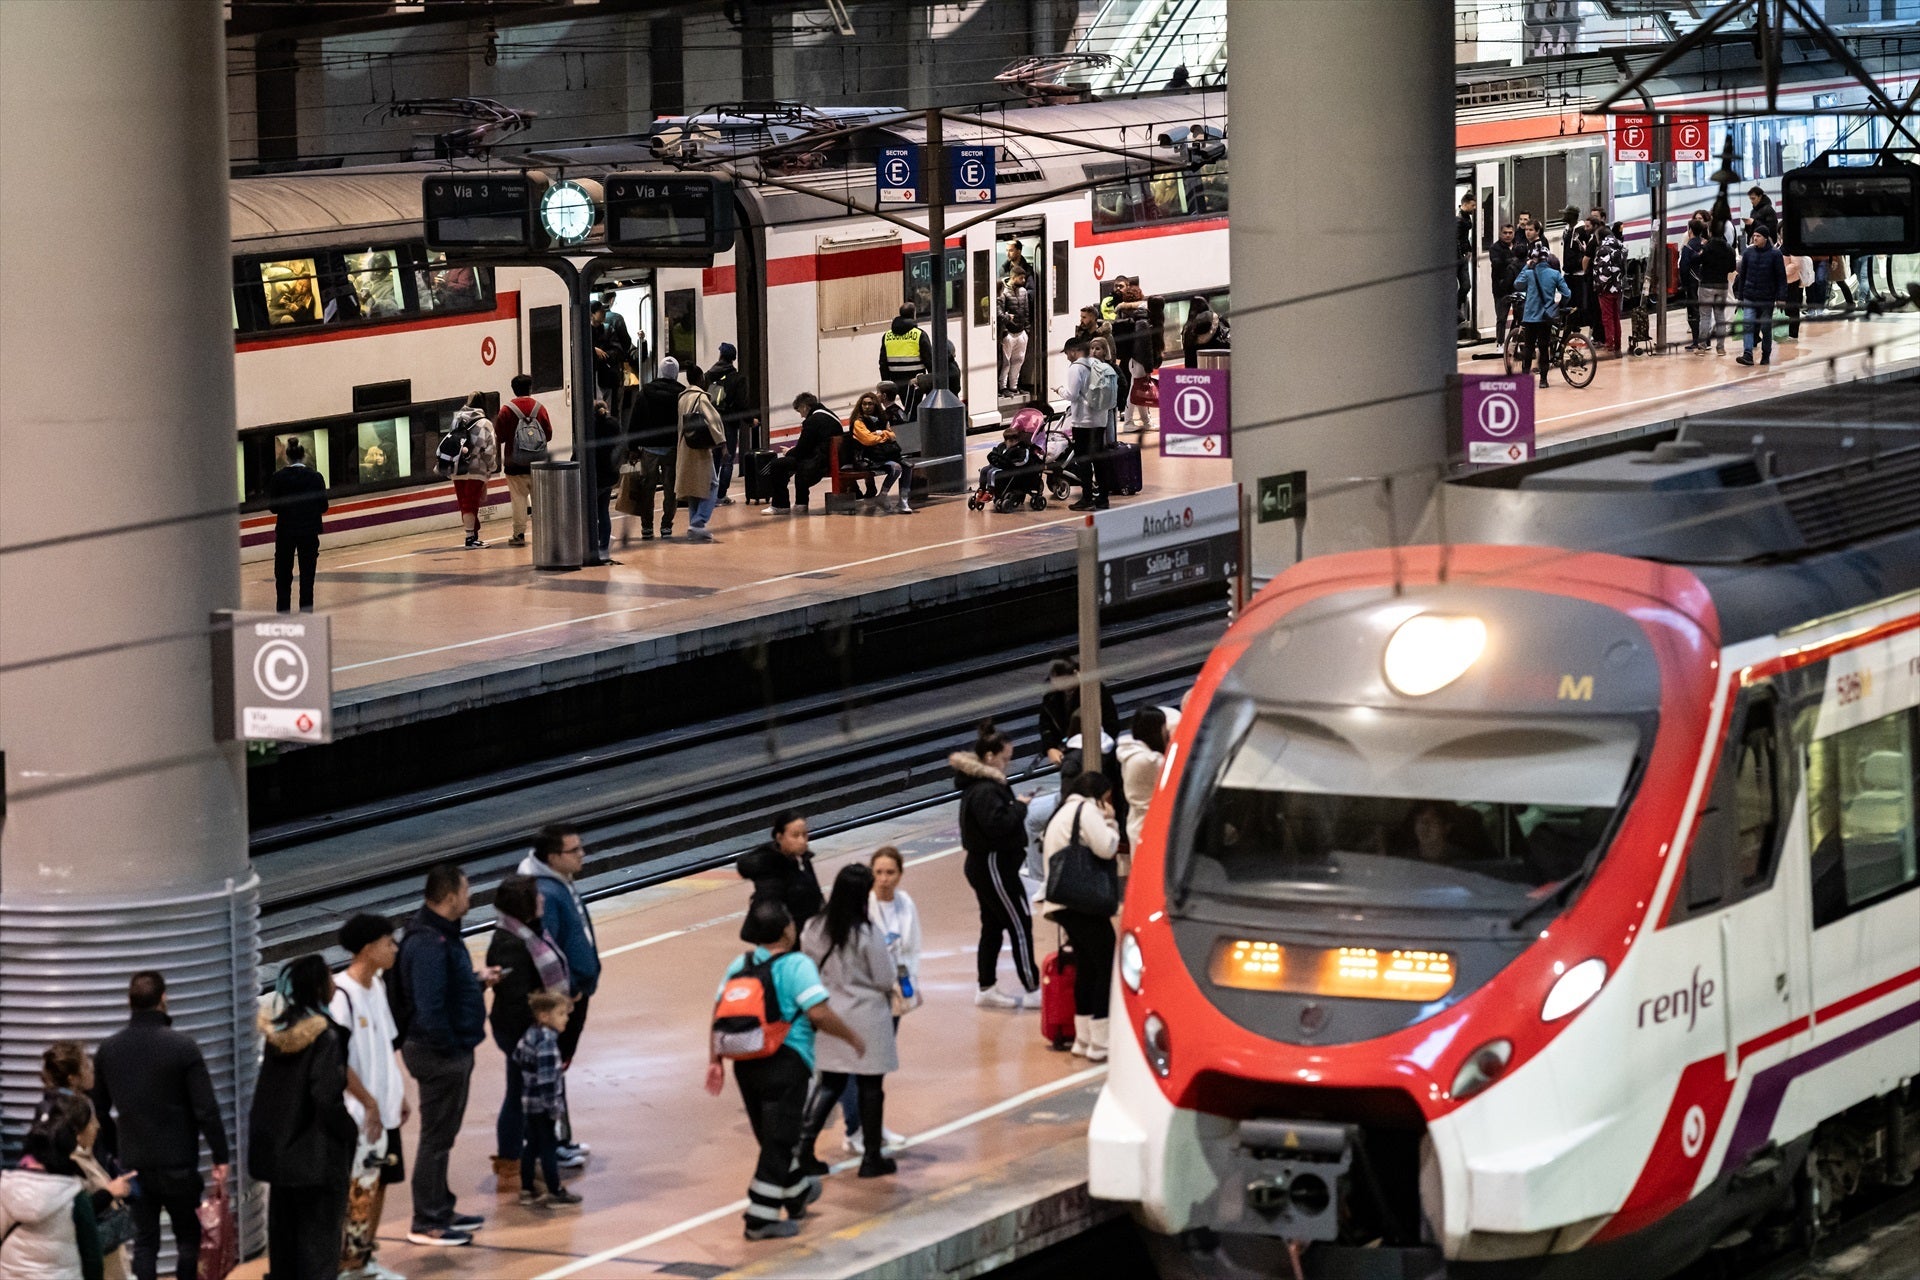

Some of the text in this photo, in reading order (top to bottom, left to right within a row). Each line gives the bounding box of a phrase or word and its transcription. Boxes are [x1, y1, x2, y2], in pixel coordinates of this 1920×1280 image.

[1628, 128, 1639, 144] F
[1685, 128, 1696, 144] F
[891, 162, 903, 182] E
[967, 164, 979, 183] E
[480, 185, 489, 198] 3
[661, 185, 670, 197] 4
[1855, 181, 1865, 195] 5
[1175, 374, 1211, 384] SECTOR
[1479, 382, 1517, 391] SECTOR
[1183, 393, 1207, 422] D
[1488, 400, 1512, 429] D
[1142, 510, 1181, 537] Atocha
[255, 623, 306, 637] SECTOR
[264, 648, 298, 691] C
[1557, 674, 1594, 701] M
[1637, 964, 1715, 1033] renfe
